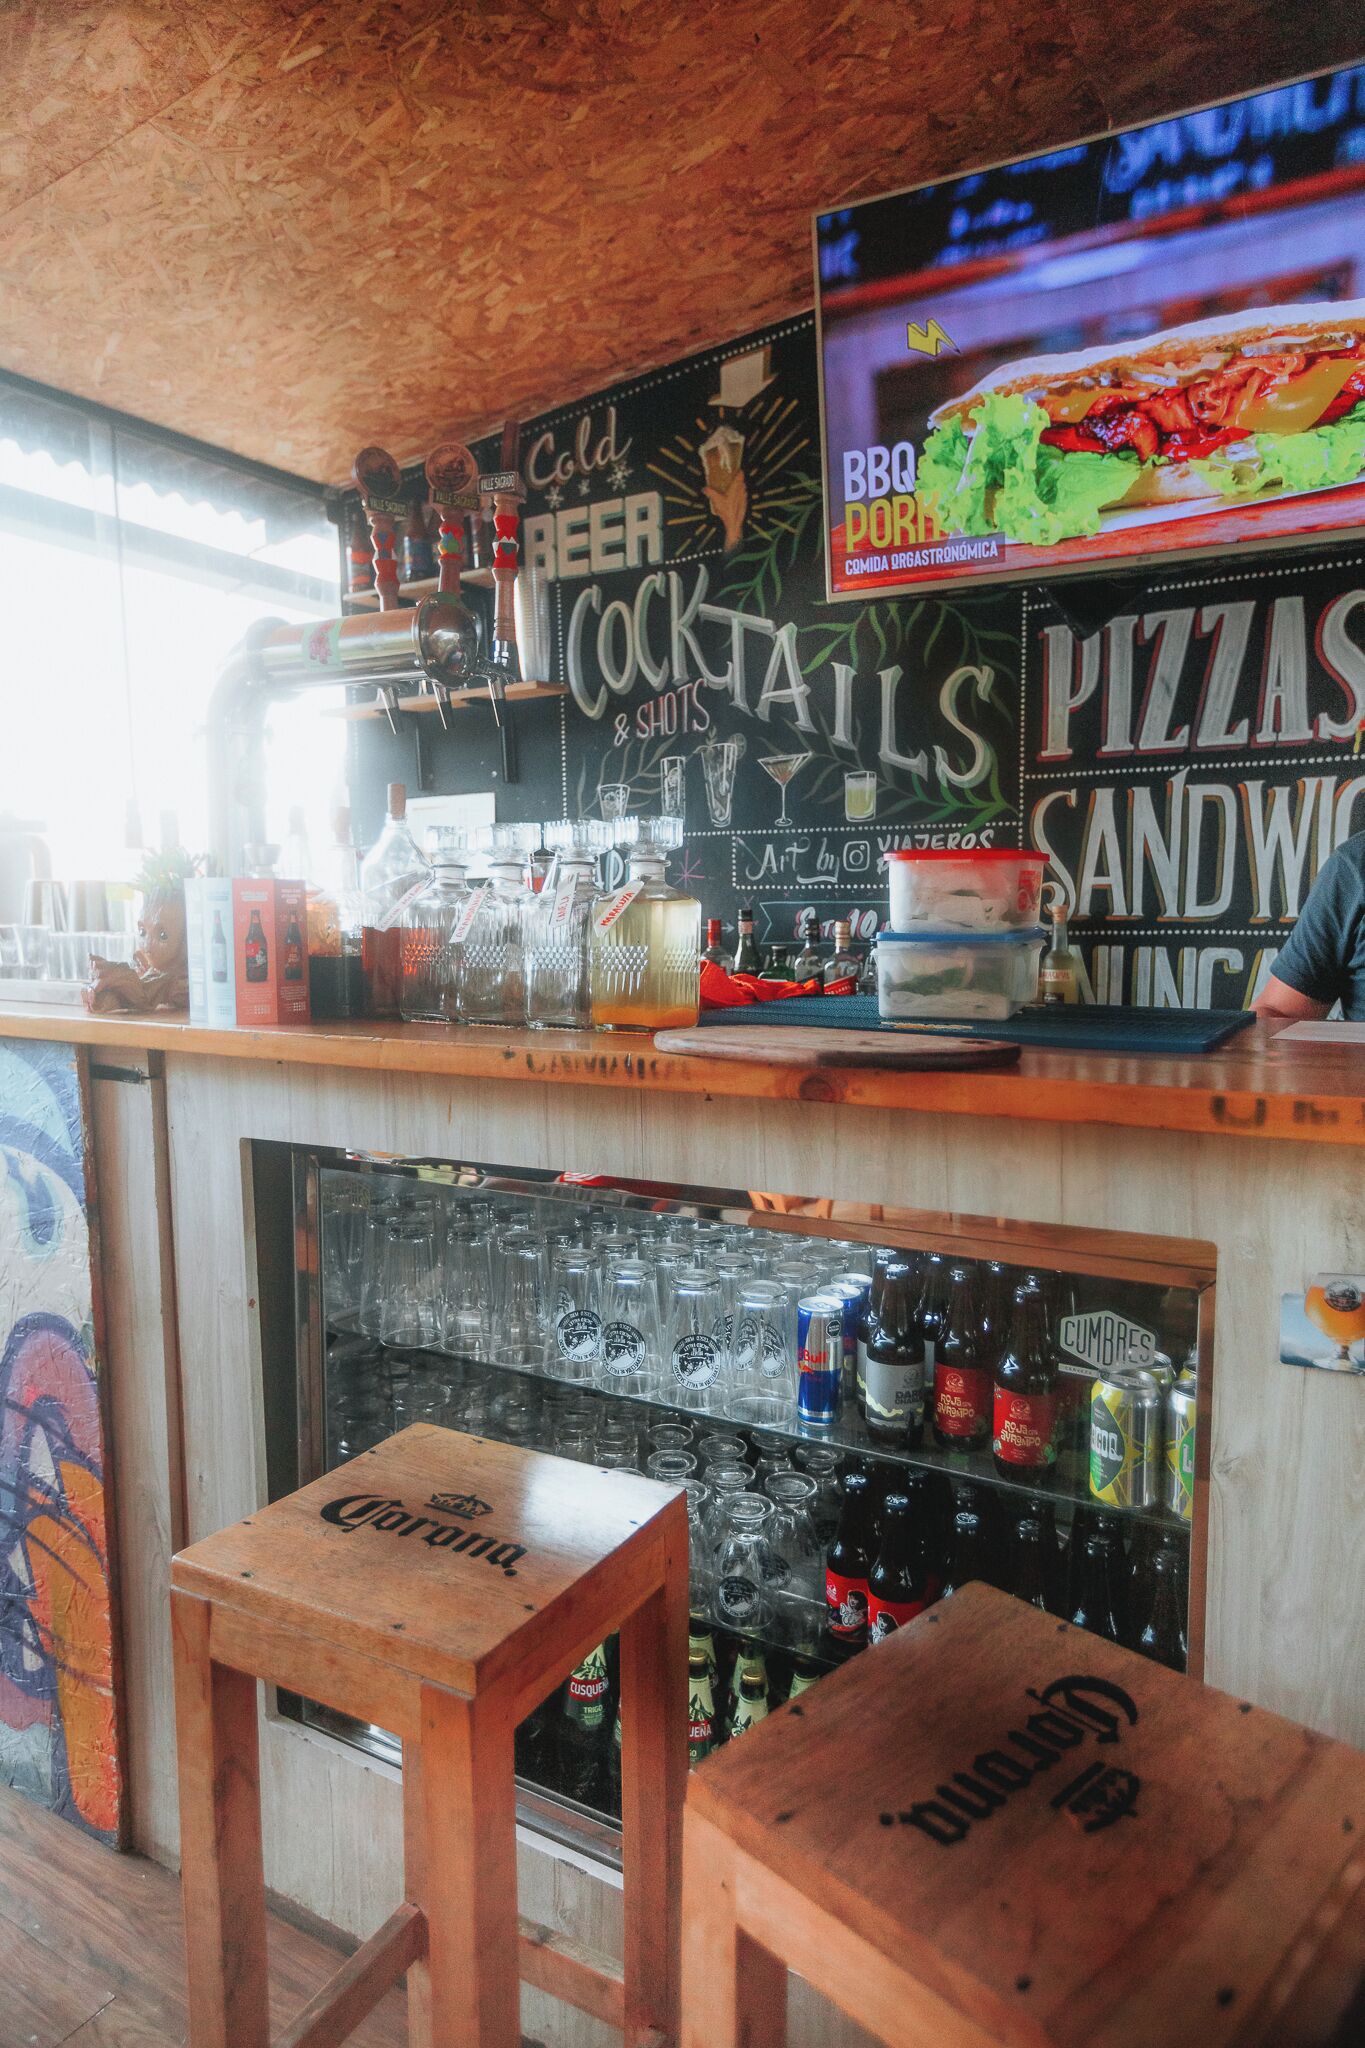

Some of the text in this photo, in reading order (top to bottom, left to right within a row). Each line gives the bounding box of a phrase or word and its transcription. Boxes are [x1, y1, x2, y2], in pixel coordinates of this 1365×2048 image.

[526, 406, 632, 490] Cold
[843, 441, 916, 502] BBQ
[524, 491, 664, 582] BEER
[845, 490, 942, 553] PORK
[845, 540, 999, 576] COMIDA ORGASTRONÓMICA
[568, 563, 997, 788] COCKTAILS
[1036, 589, 1365, 762] PIZZAS
[613, 677, 711, 746] & SHOTS
[745, 836, 811, 881] Art
[796, 836, 840, 884] by
[876, 828, 995, 852] VIAJEROS
[803, 1349, 828, 1363] Bull
[1064, 1316, 1151, 1367] CUMBRES
[320, 1494, 529, 1570] Corona
[583, 1704, 604, 1714] TRIGO
[899, 1674, 1139, 1846] Corona
